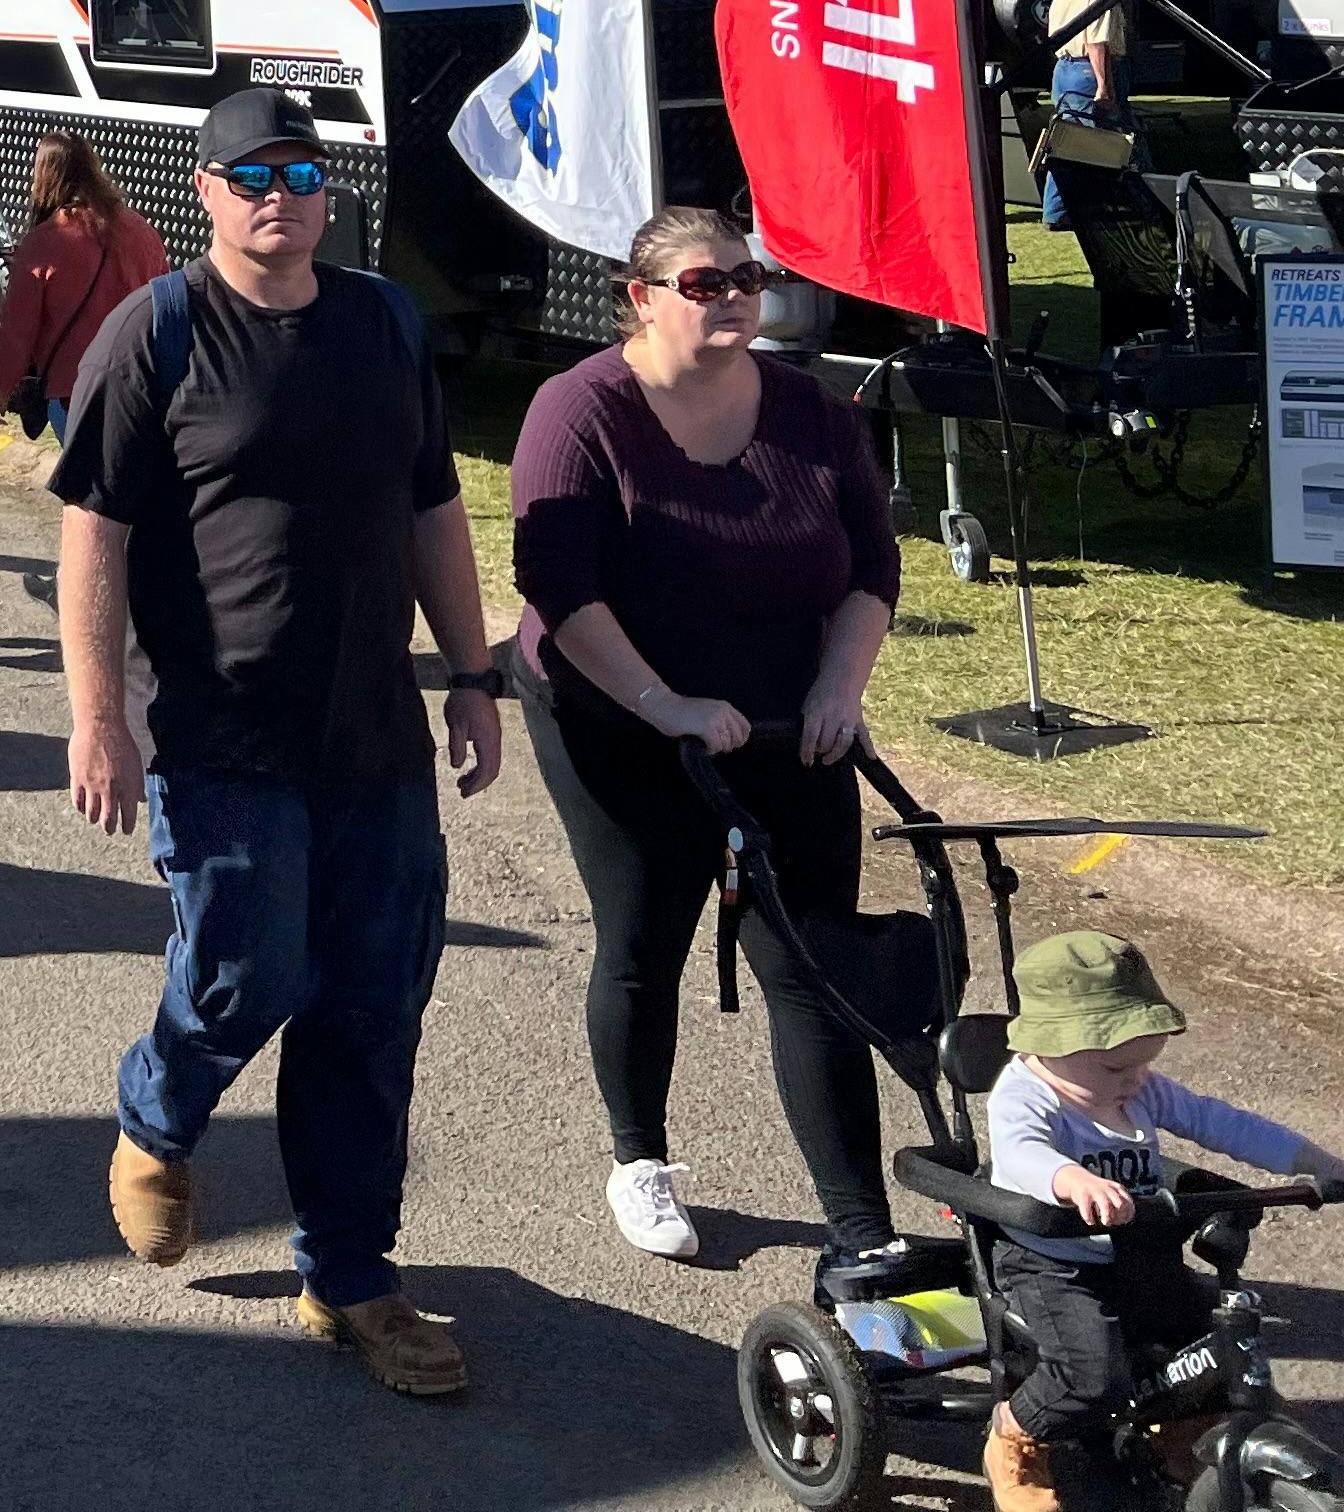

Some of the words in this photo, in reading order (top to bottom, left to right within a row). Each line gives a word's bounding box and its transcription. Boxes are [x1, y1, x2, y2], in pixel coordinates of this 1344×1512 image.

[251, 59, 364, 87] ROUGHRIDER
[1272, 269, 1341, 282] RETREATS
[1274, 284, 1344, 302] TIMBE
